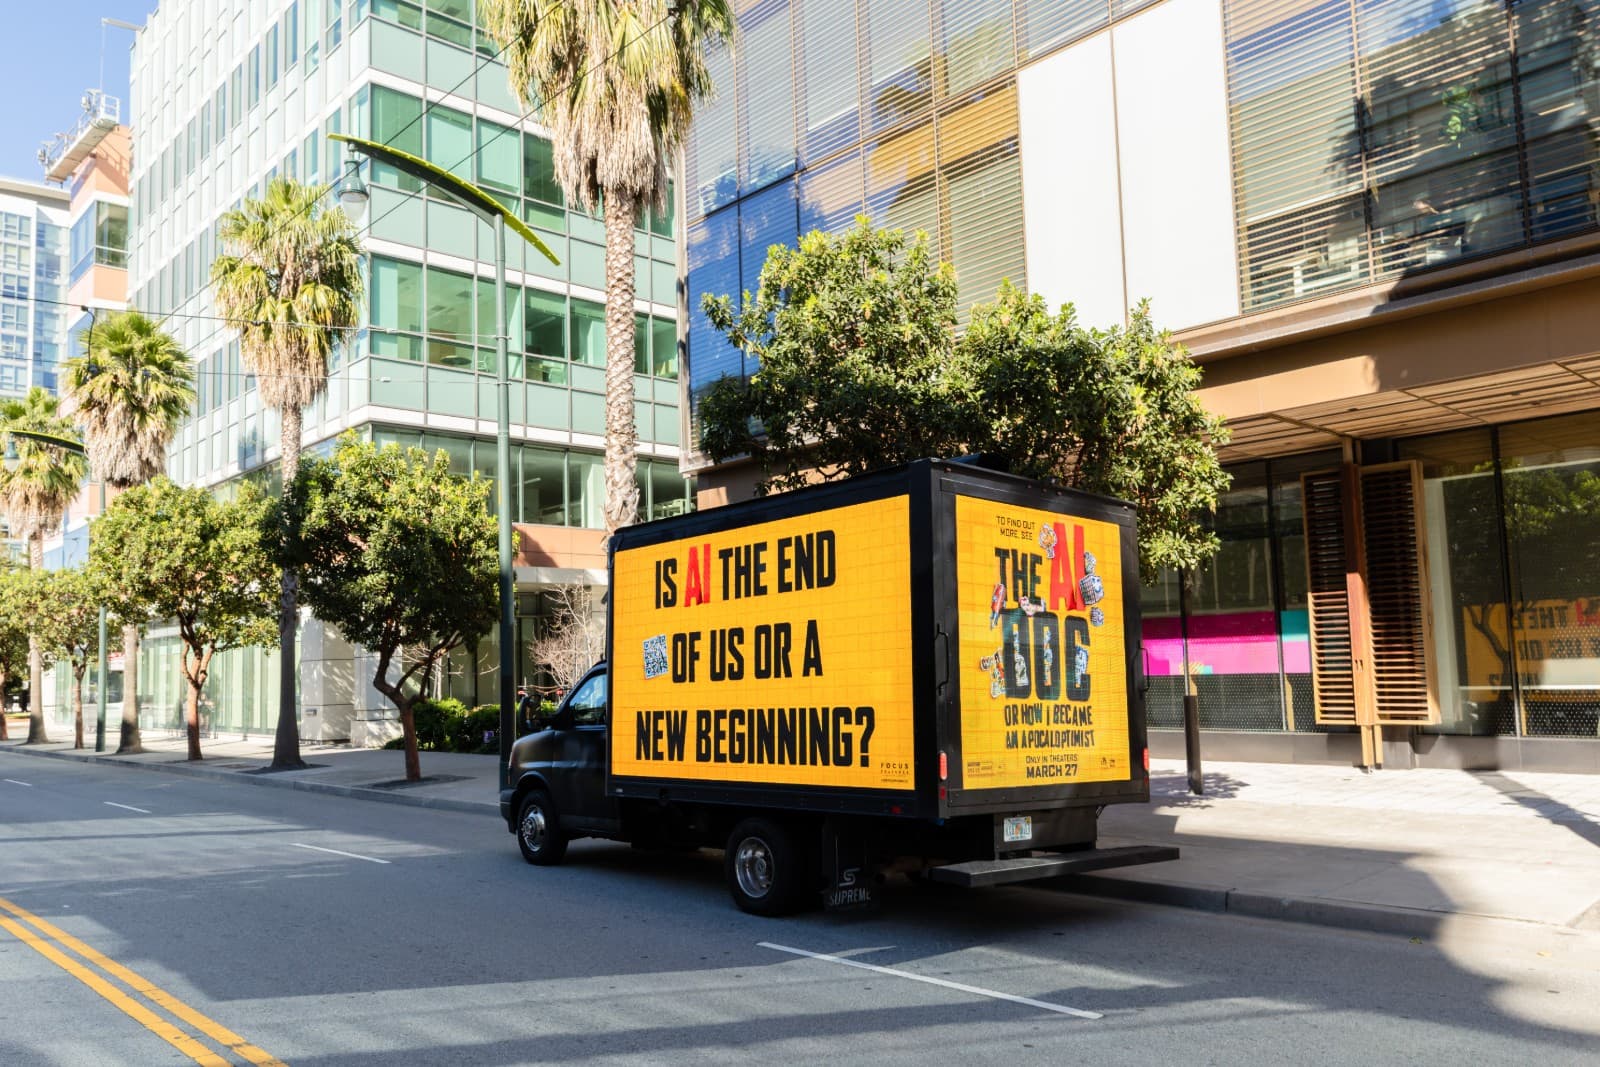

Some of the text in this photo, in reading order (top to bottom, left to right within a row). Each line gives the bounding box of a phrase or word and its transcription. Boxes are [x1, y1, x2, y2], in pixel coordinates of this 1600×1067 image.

[996, 516, 1035, 530] TO FIND OUT
[1021, 531, 1033, 541] SEE
[655, 530, 836, 609] IS AI THE END
[994, 521, 1086, 612] THE AI
[672, 619, 823, 683] OF US OR A
[1001, 608, 1091, 703] DOC
[1004, 705, 1018, 726] OR
[1021, 703, 1042, 726] HOW
[1053, 704, 1093, 727] BECAME
[636, 706, 875, 768] NEW BEGINNING?
[1006, 729, 1095, 749] AN APOCALOPTIMIST
[1025, 753, 1078, 764] ONLY IN THEATERS
[1026, 763, 1078, 779] MARCH 27
